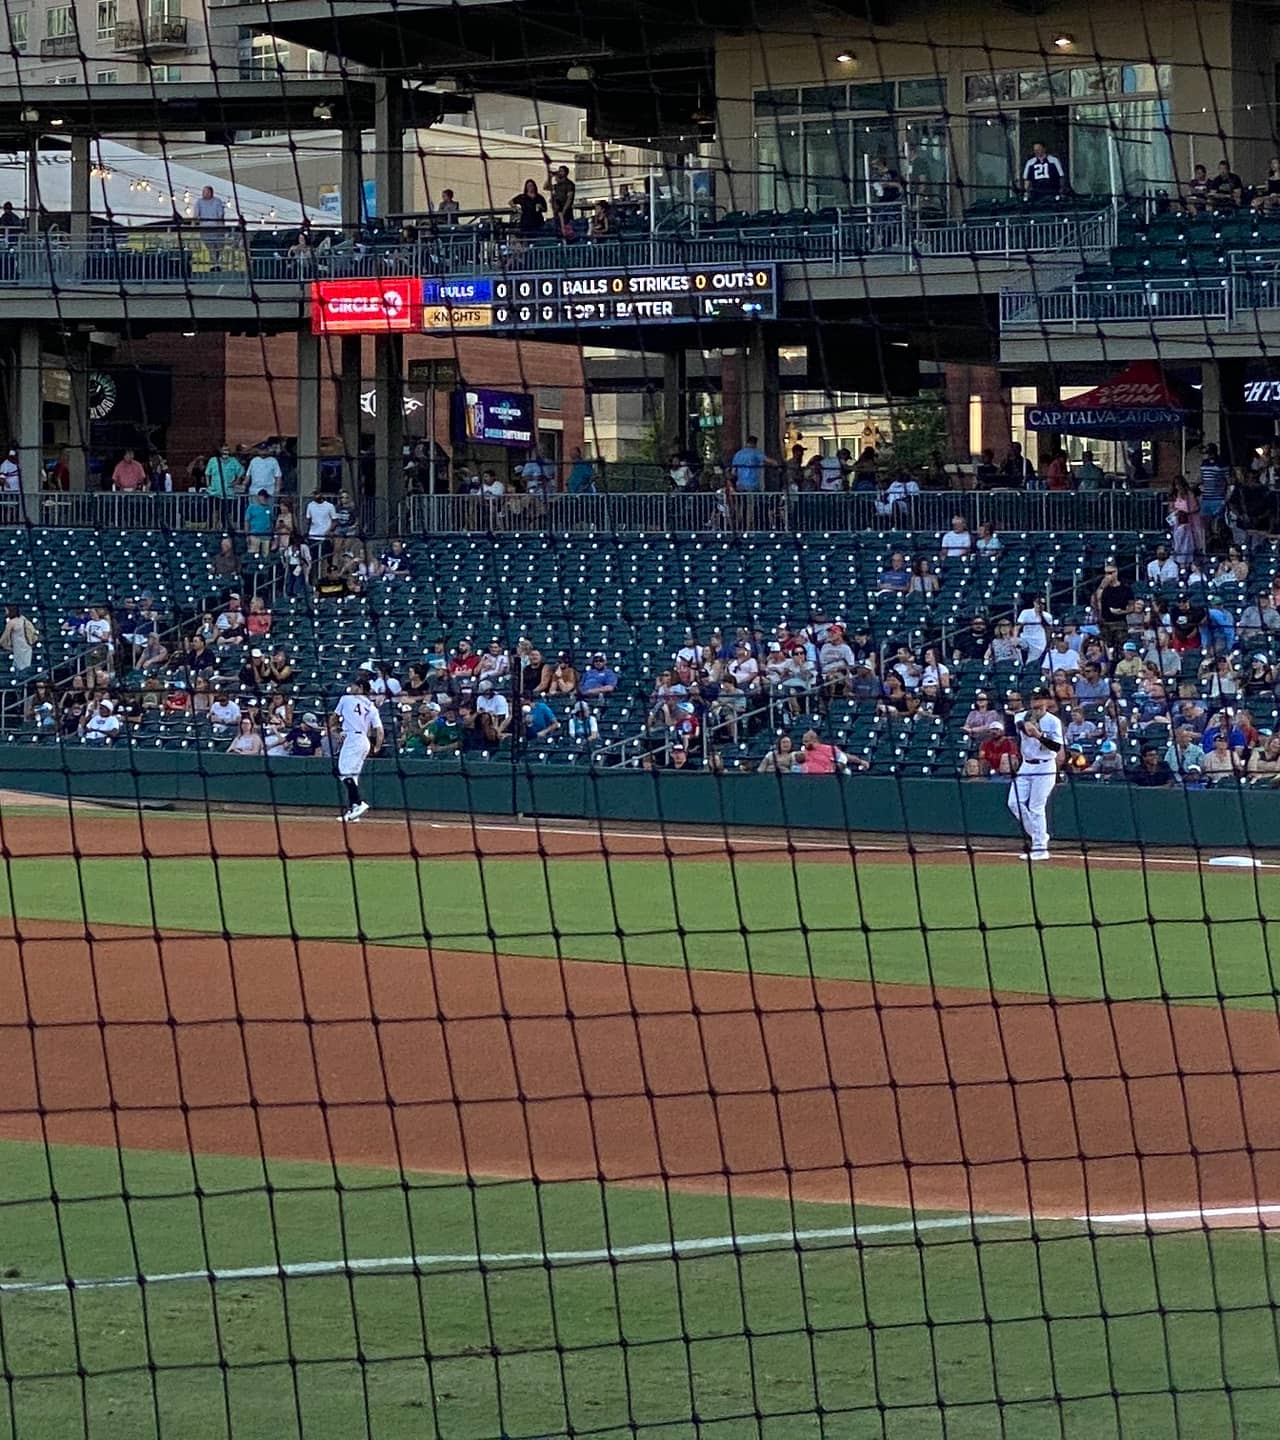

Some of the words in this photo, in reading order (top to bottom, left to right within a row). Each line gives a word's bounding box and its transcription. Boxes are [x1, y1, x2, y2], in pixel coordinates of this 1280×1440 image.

[1033, 162, 1050, 179] 21
[496, 285, 507, 298] 0
[519, 282, 530, 297] 0
[542, 281, 553, 296] 0
[562, 279, 608, 296] BALLS
[612, 278, 623, 293] 0
[628, 275, 690, 293] STRIKES
[695, 274, 707, 289] 0
[712, 271, 754, 289] OUTS
[755, 271, 767, 286] 0
[327, 296, 380, 314] CIRCLE
[433, 310, 481, 323] KNGHTS
[496, 307, 508, 322] 0
[519, 307, 530, 321] 0
[542, 306, 553, 320] 0
